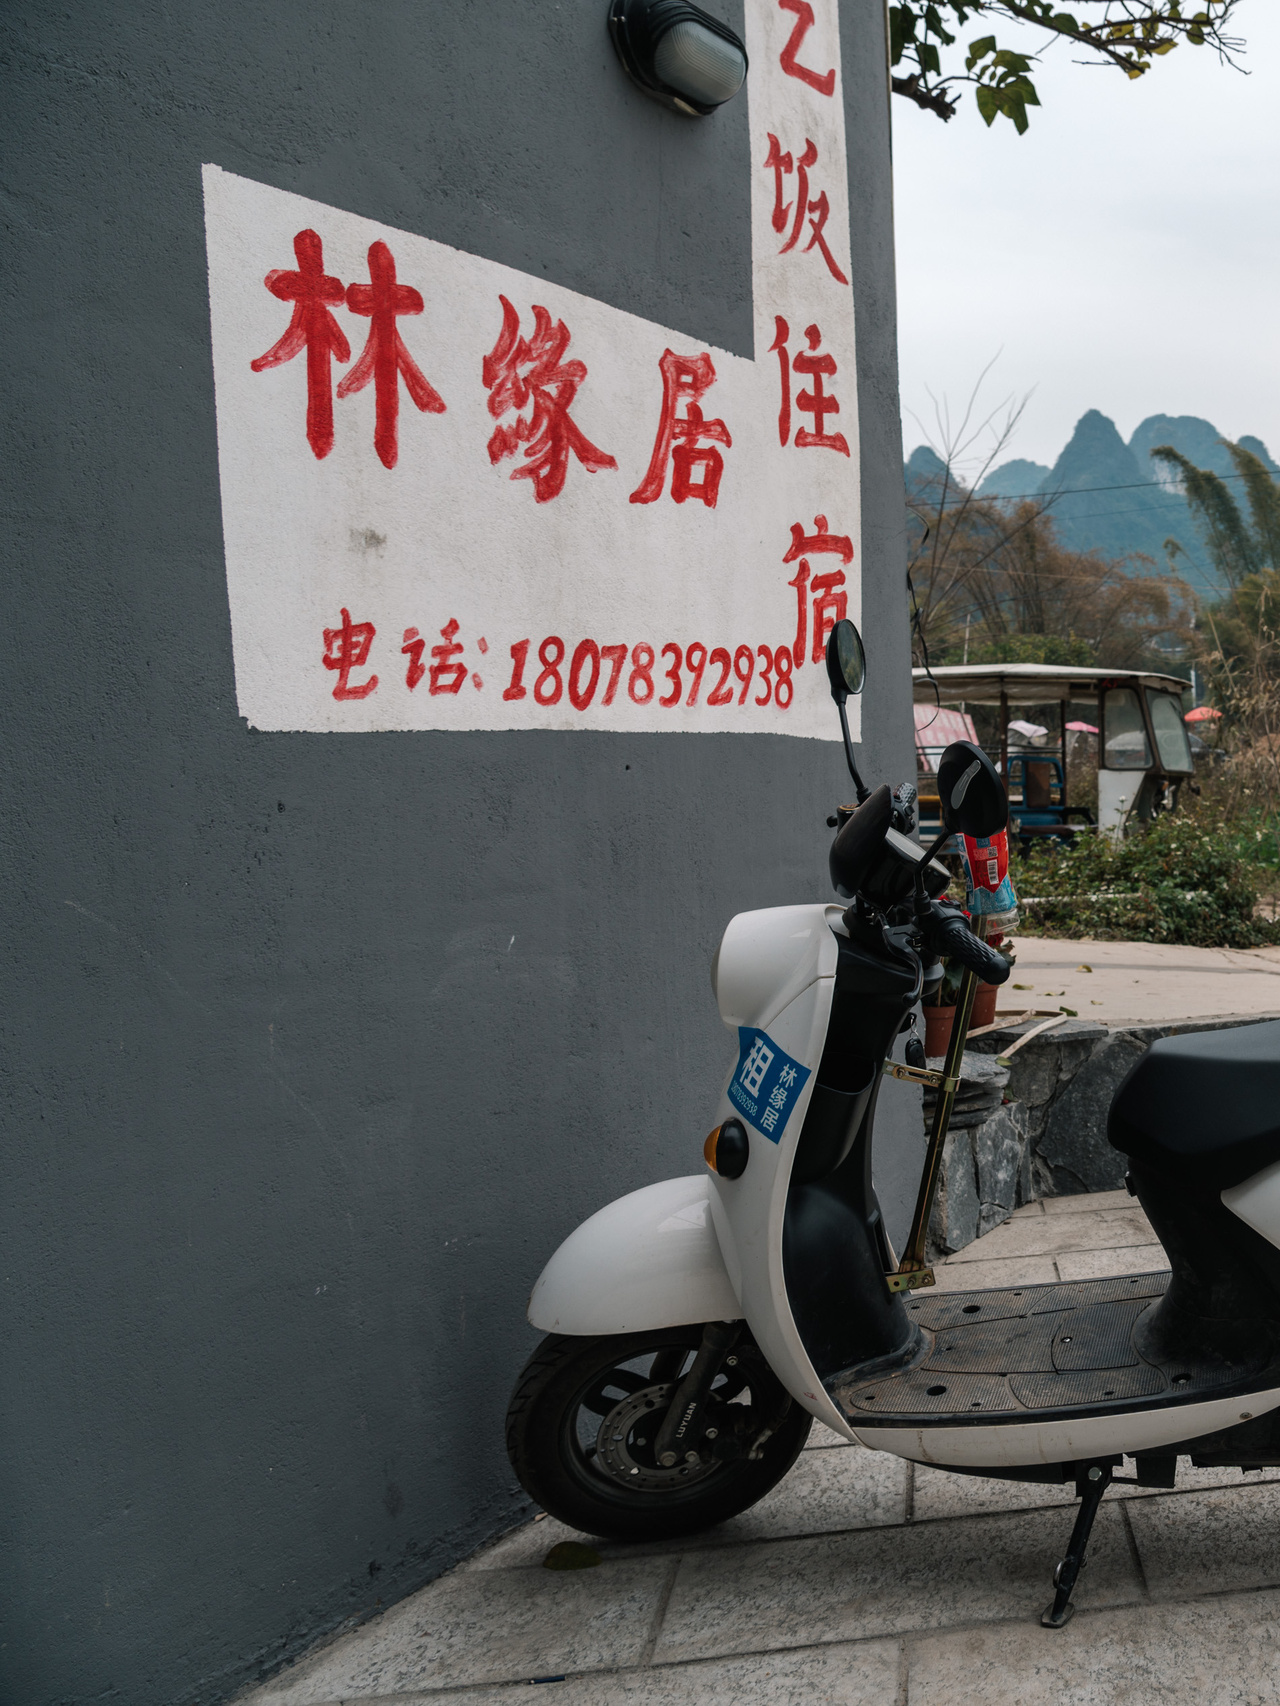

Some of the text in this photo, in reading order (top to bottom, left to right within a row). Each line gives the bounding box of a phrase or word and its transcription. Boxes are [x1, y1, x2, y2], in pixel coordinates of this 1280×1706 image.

[251, 229, 733, 510] 林缘居
[740, 1036, 775, 1099] 租
[760, 1063, 798, 1133] 林缘居
[675, 1402, 698, 1438] LUYUAN
